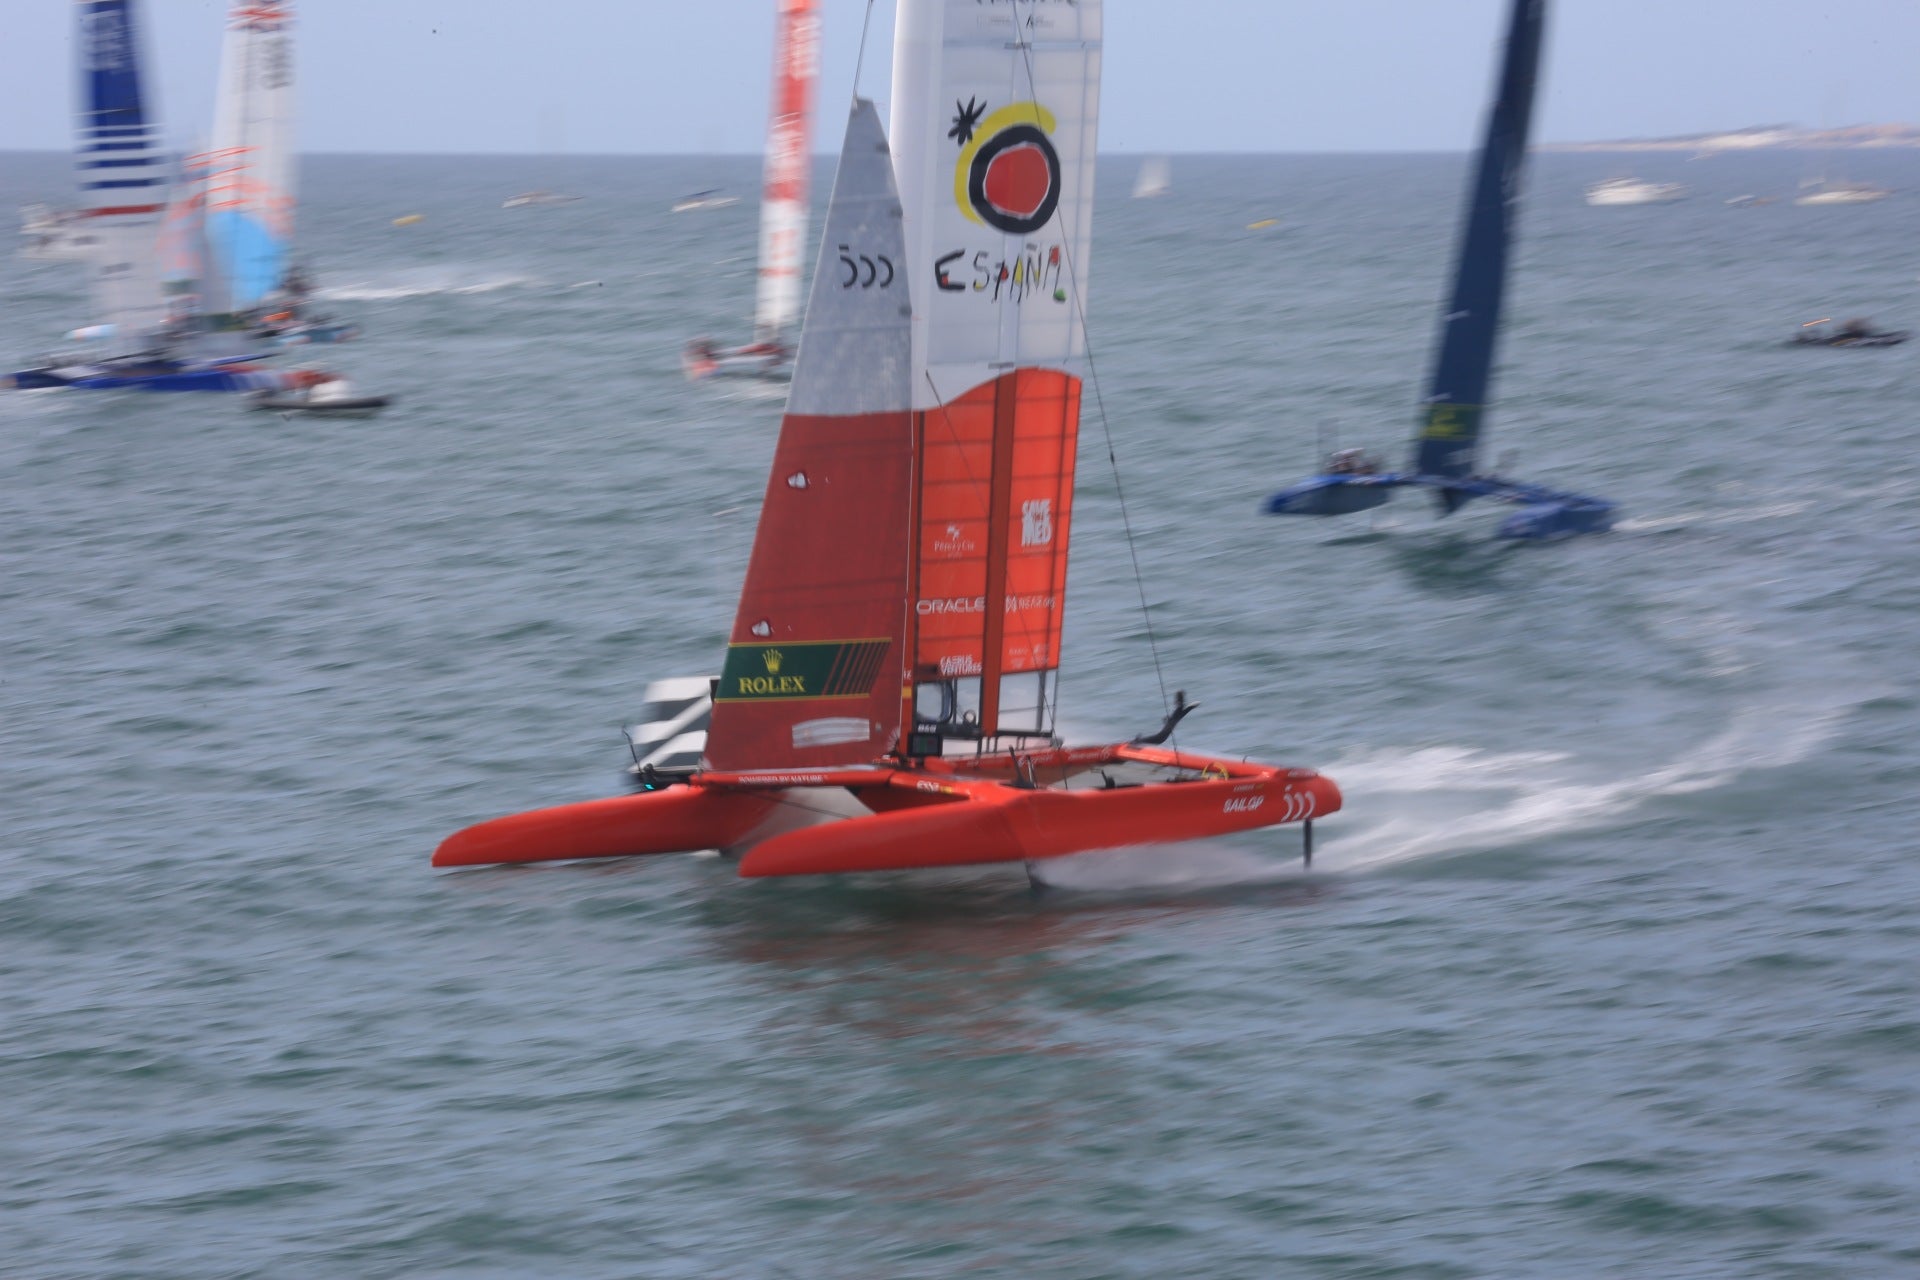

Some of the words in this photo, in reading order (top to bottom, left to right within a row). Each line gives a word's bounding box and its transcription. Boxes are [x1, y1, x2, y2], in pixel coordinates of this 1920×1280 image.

[935, 243, 1066, 304] ESPAÑA
[916, 597, 986, 615] ORACLE
[738, 676, 806, 695] ROLEX
